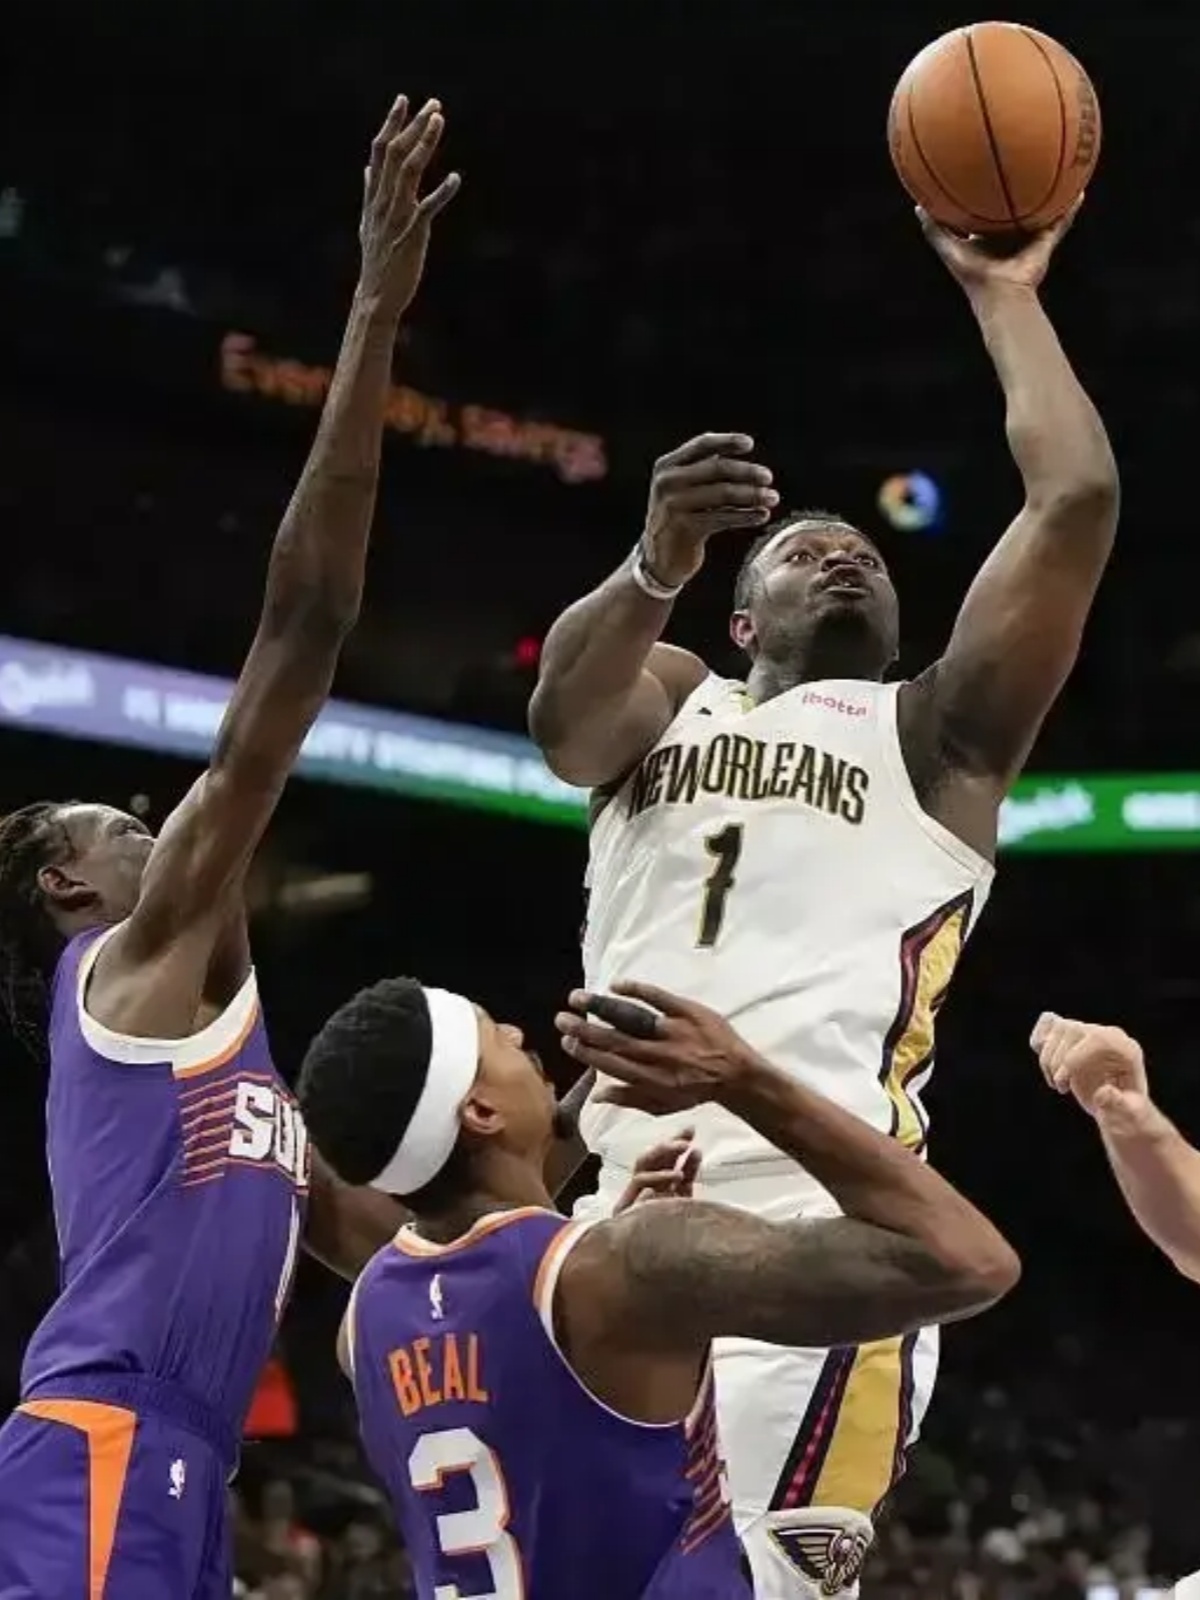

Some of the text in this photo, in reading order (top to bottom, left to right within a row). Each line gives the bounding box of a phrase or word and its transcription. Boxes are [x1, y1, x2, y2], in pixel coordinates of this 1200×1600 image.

[625, 744, 701, 822] NEW
[701, 733, 869, 825] ORLEANS
[695, 821, 744, 949] 1
[387, 1332, 488, 1417] BEAL
[408, 1427, 525, 1600] 3
